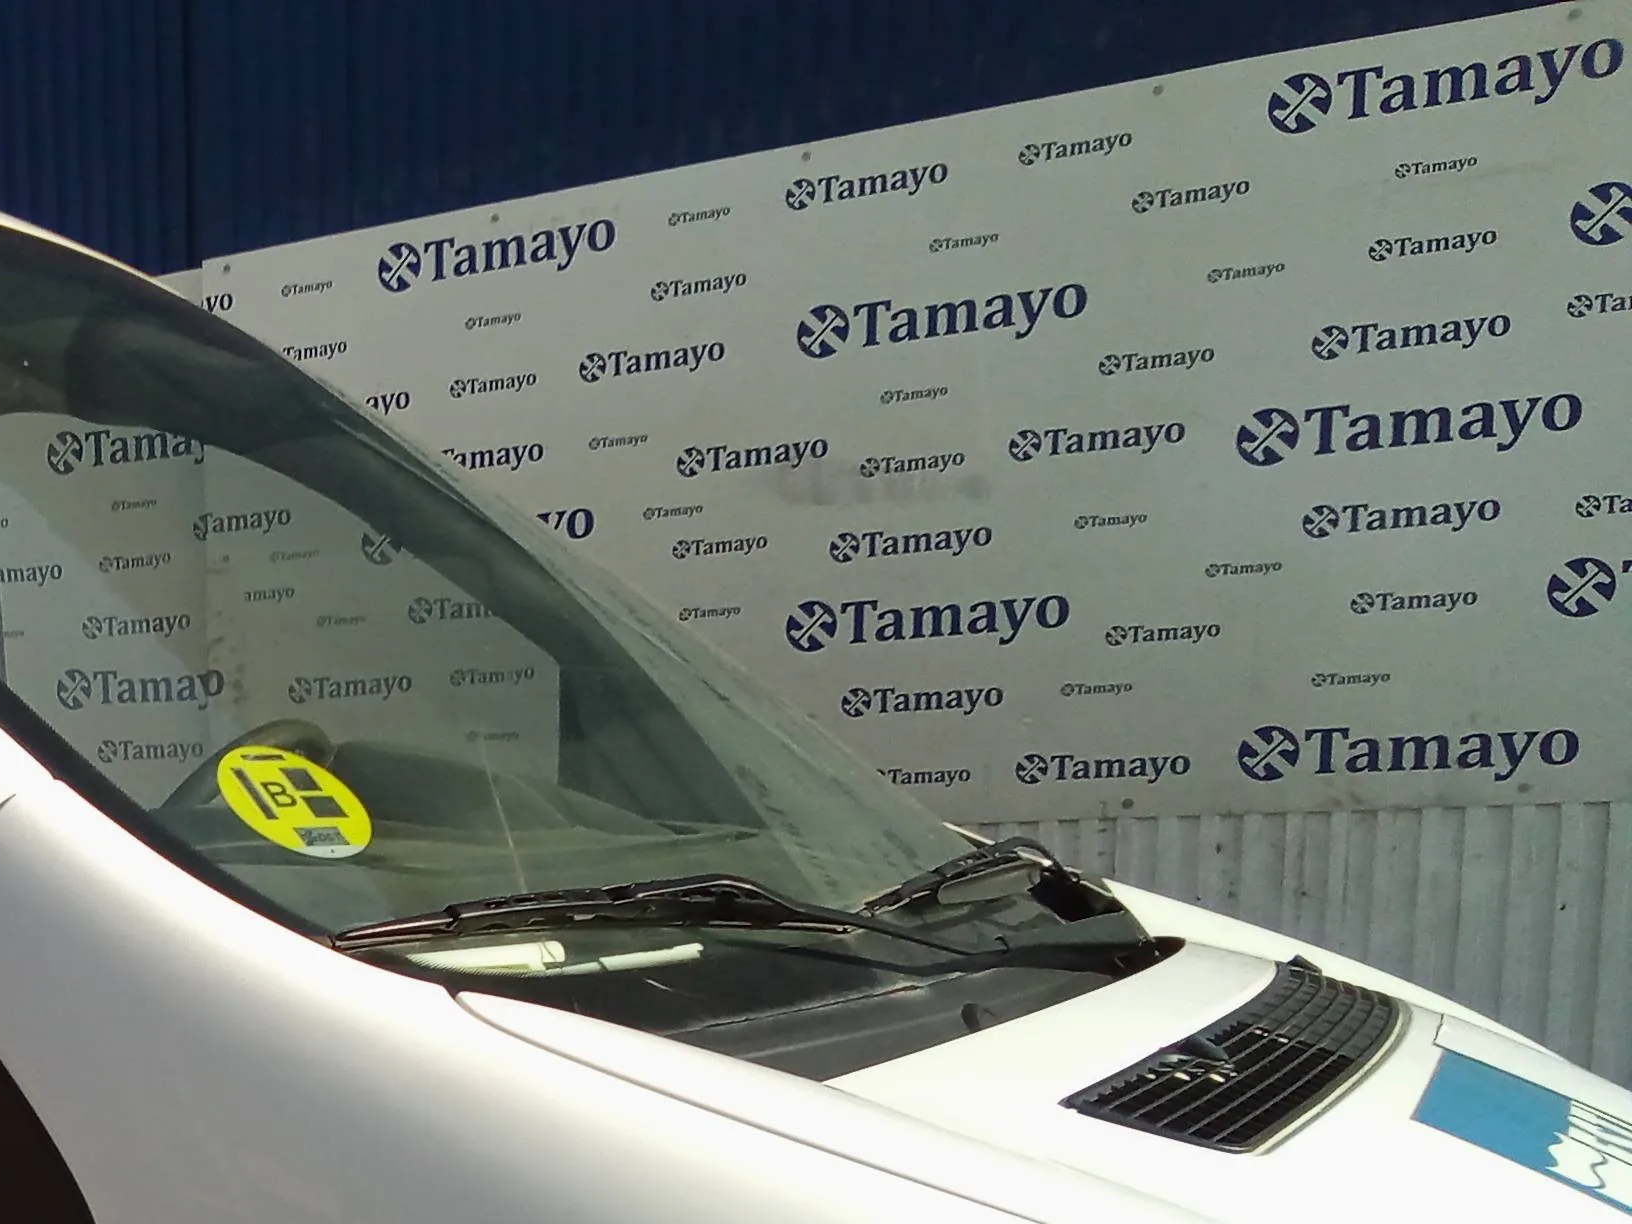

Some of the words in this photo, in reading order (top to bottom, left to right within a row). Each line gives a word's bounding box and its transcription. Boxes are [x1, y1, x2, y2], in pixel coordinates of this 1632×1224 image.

[1337, 38, 1625, 121] Tamayo
[1041, 132, 1133, 162] Tamayo
[1411, 156, 1478, 176] Tamayo
[818, 163, 948, 204] Tamayo
[1155, 180, 1250, 209] Tamayo
[683, 207, 731, 224] Tamayo
[424, 215, 616, 283] Tamayo
[944, 233, 999, 251] Tamayo
[1394, 230, 1498, 258] Tamayo
[1223, 262, 1286, 281] Tamayo
[292, 280, 333, 296] Tamayo
[671, 273, 747, 298] Tamayo
[476, 313, 522, 328] Tamayo
[853, 283, 1088, 349] Tamayo
[1352, 314, 1511, 354] Tamayo
[608, 342, 725, 377] Tamayo
[1122, 347, 1215, 373] Tamayo
[468, 373, 537, 395] Tamayo
[894, 386, 949, 403] Tamayo
[1305, 393, 1583, 457] Tamayo
[85, 429, 205, 468] Tama
[603, 434, 649, 449] Tamayo
[1044, 422, 1186, 457] Tamayo
[707, 438, 829, 473] Tamayo
[880, 452, 966, 475] Tamayo
[656, 504, 704, 519] Tamayo
[1089, 513, 1148, 528] Tamayo
[1342, 499, 1501, 534] Tamayo
[691, 535, 768, 557] Tamayo
[862, 526, 992, 559] Tamayo
[114, 552, 171, 571] Tamayo
[1220, 561, 1283, 576] Tamayo
[245, 587, 296, 603] amayo
[1376, 591, 1479, 613] Tamayo
[692, 606, 742, 620] Tamayo
[841, 594, 1070, 646] Tamayo
[103, 614, 191, 639] Tamayo
[1128, 623, 1221, 644] Tamayo
[314, 675, 412, 701] Tamayo
[1075, 682, 1133, 697] Tamayo
[1327, 672, 1391, 687] Tamayo
[874, 687, 1004, 716] Tamayo
[119, 740, 204, 763] Tamayo
[1305, 727, 1580, 782] Tamayo
[888, 768, 971, 788] Tamayo
[1051, 754, 1191, 785] Tamayo
[261, 782, 297, 807] B
